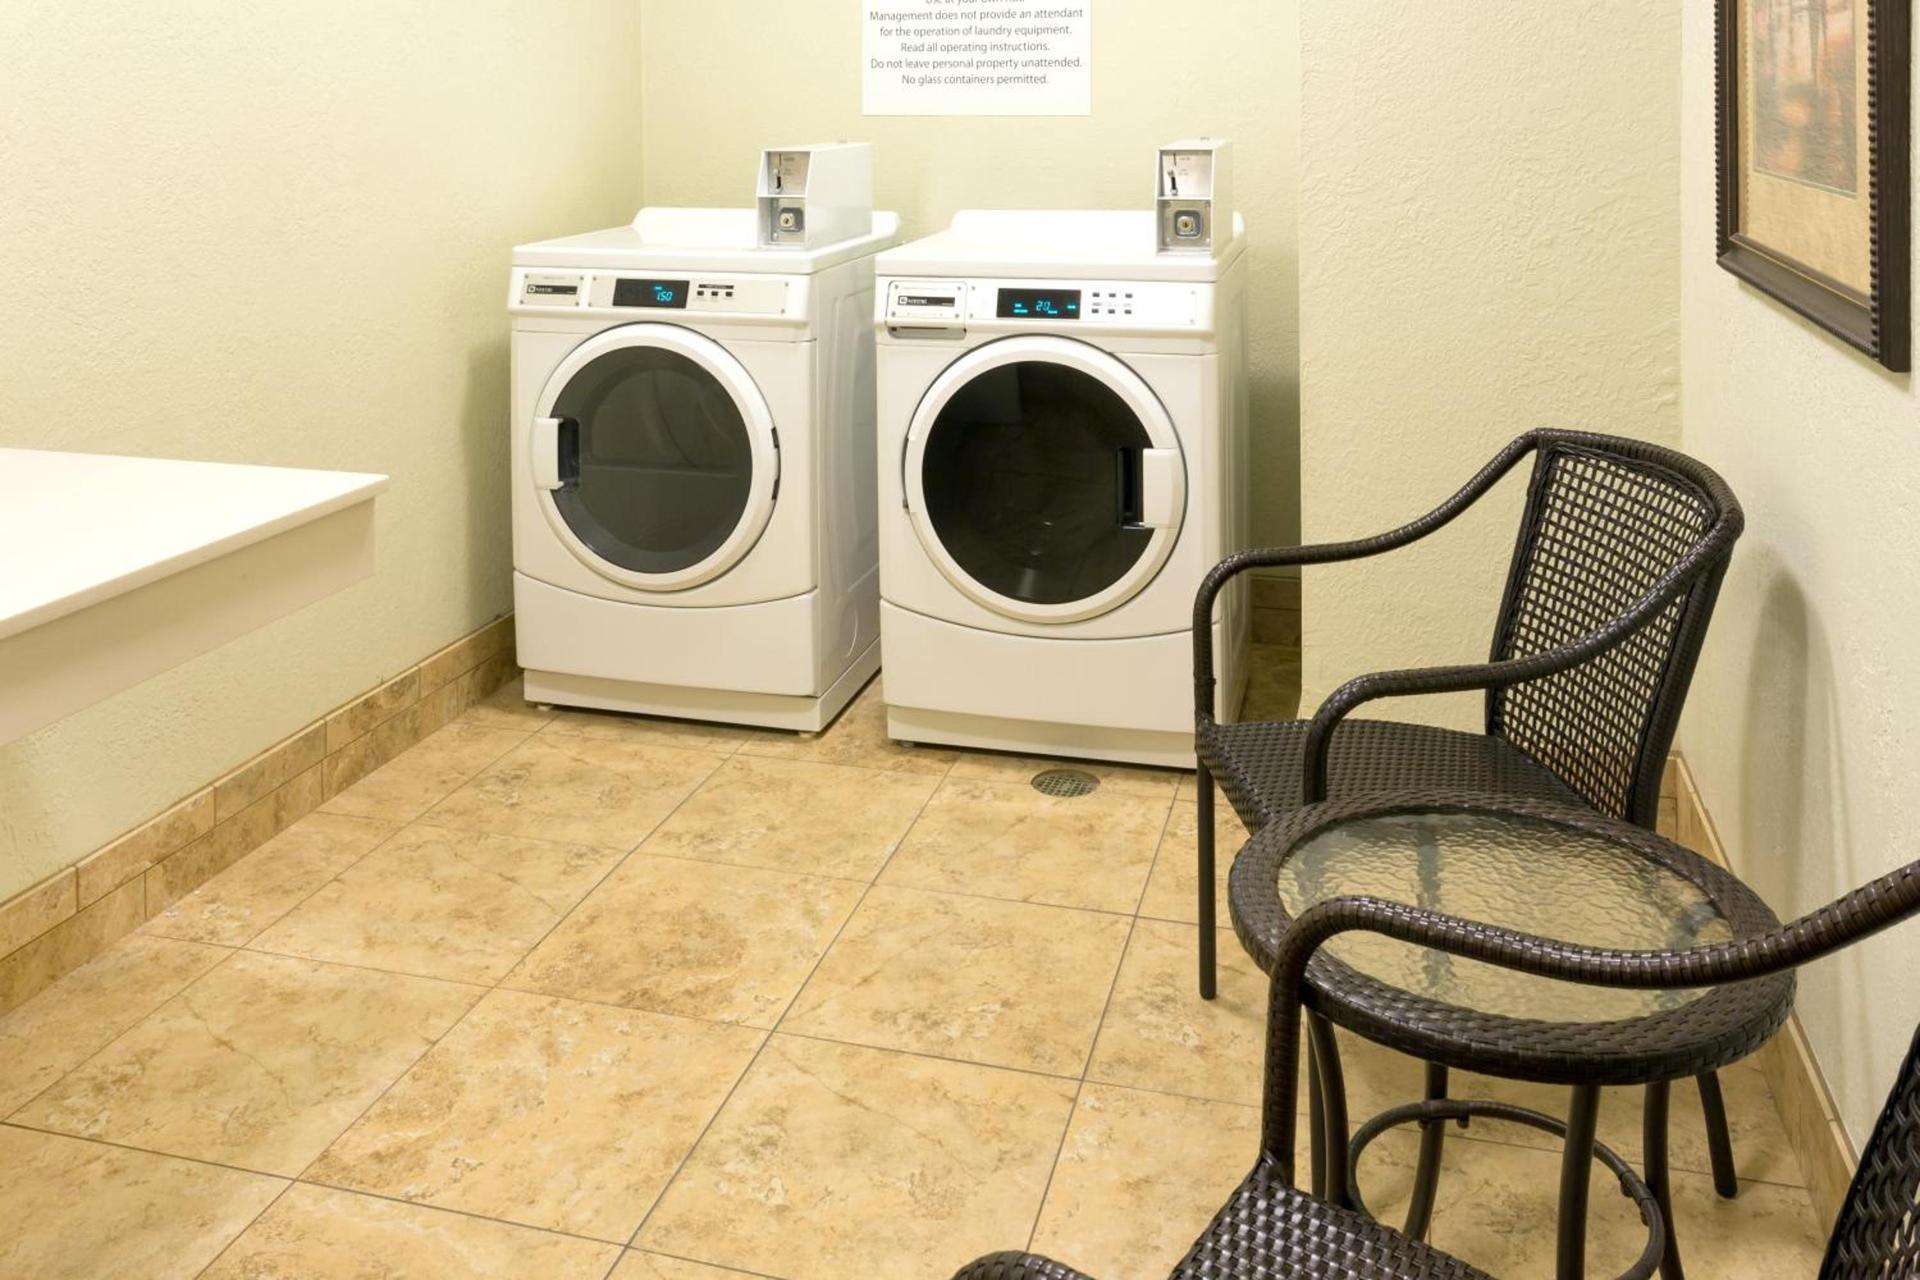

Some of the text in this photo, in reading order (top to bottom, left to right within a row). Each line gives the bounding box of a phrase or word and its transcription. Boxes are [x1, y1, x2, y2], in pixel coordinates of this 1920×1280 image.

[870, 9, 1083, 22] Management does not provide an attendant
[880, 25, 1072, 38] for the operation of laundry equipment.
[901, 42, 1050, 54] Read all operating instructions.
[871, 58, 1082, 70] Do not leave personal property unattended.
[902, 74, 1048, 86] No glass containers permitted.
